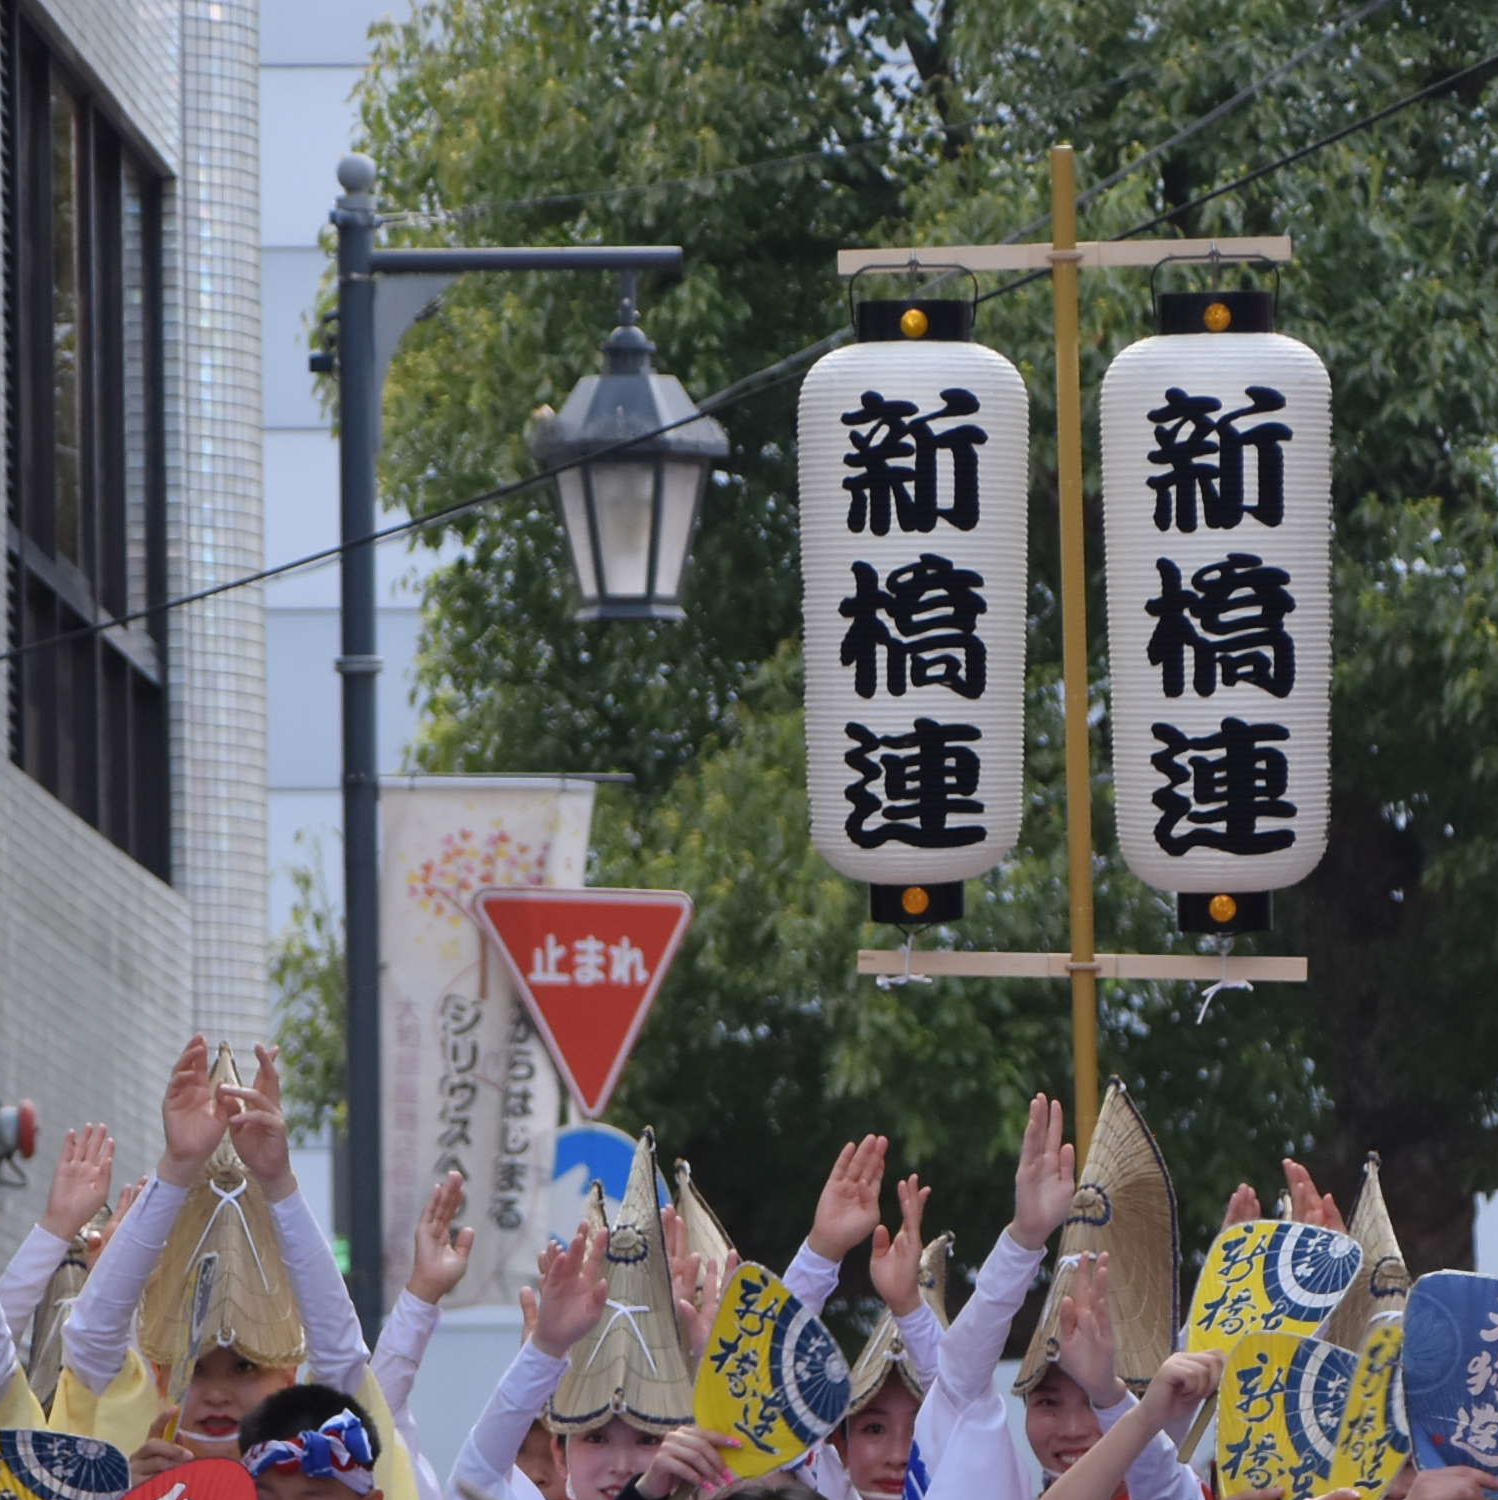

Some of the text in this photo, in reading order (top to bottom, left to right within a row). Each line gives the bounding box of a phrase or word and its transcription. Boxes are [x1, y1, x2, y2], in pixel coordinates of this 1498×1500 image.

[838, 387, 989, 850] 新橋連
[1145, 385, 1297, 857] 新橋連
[529, 933, 650, 987] 止まれ
